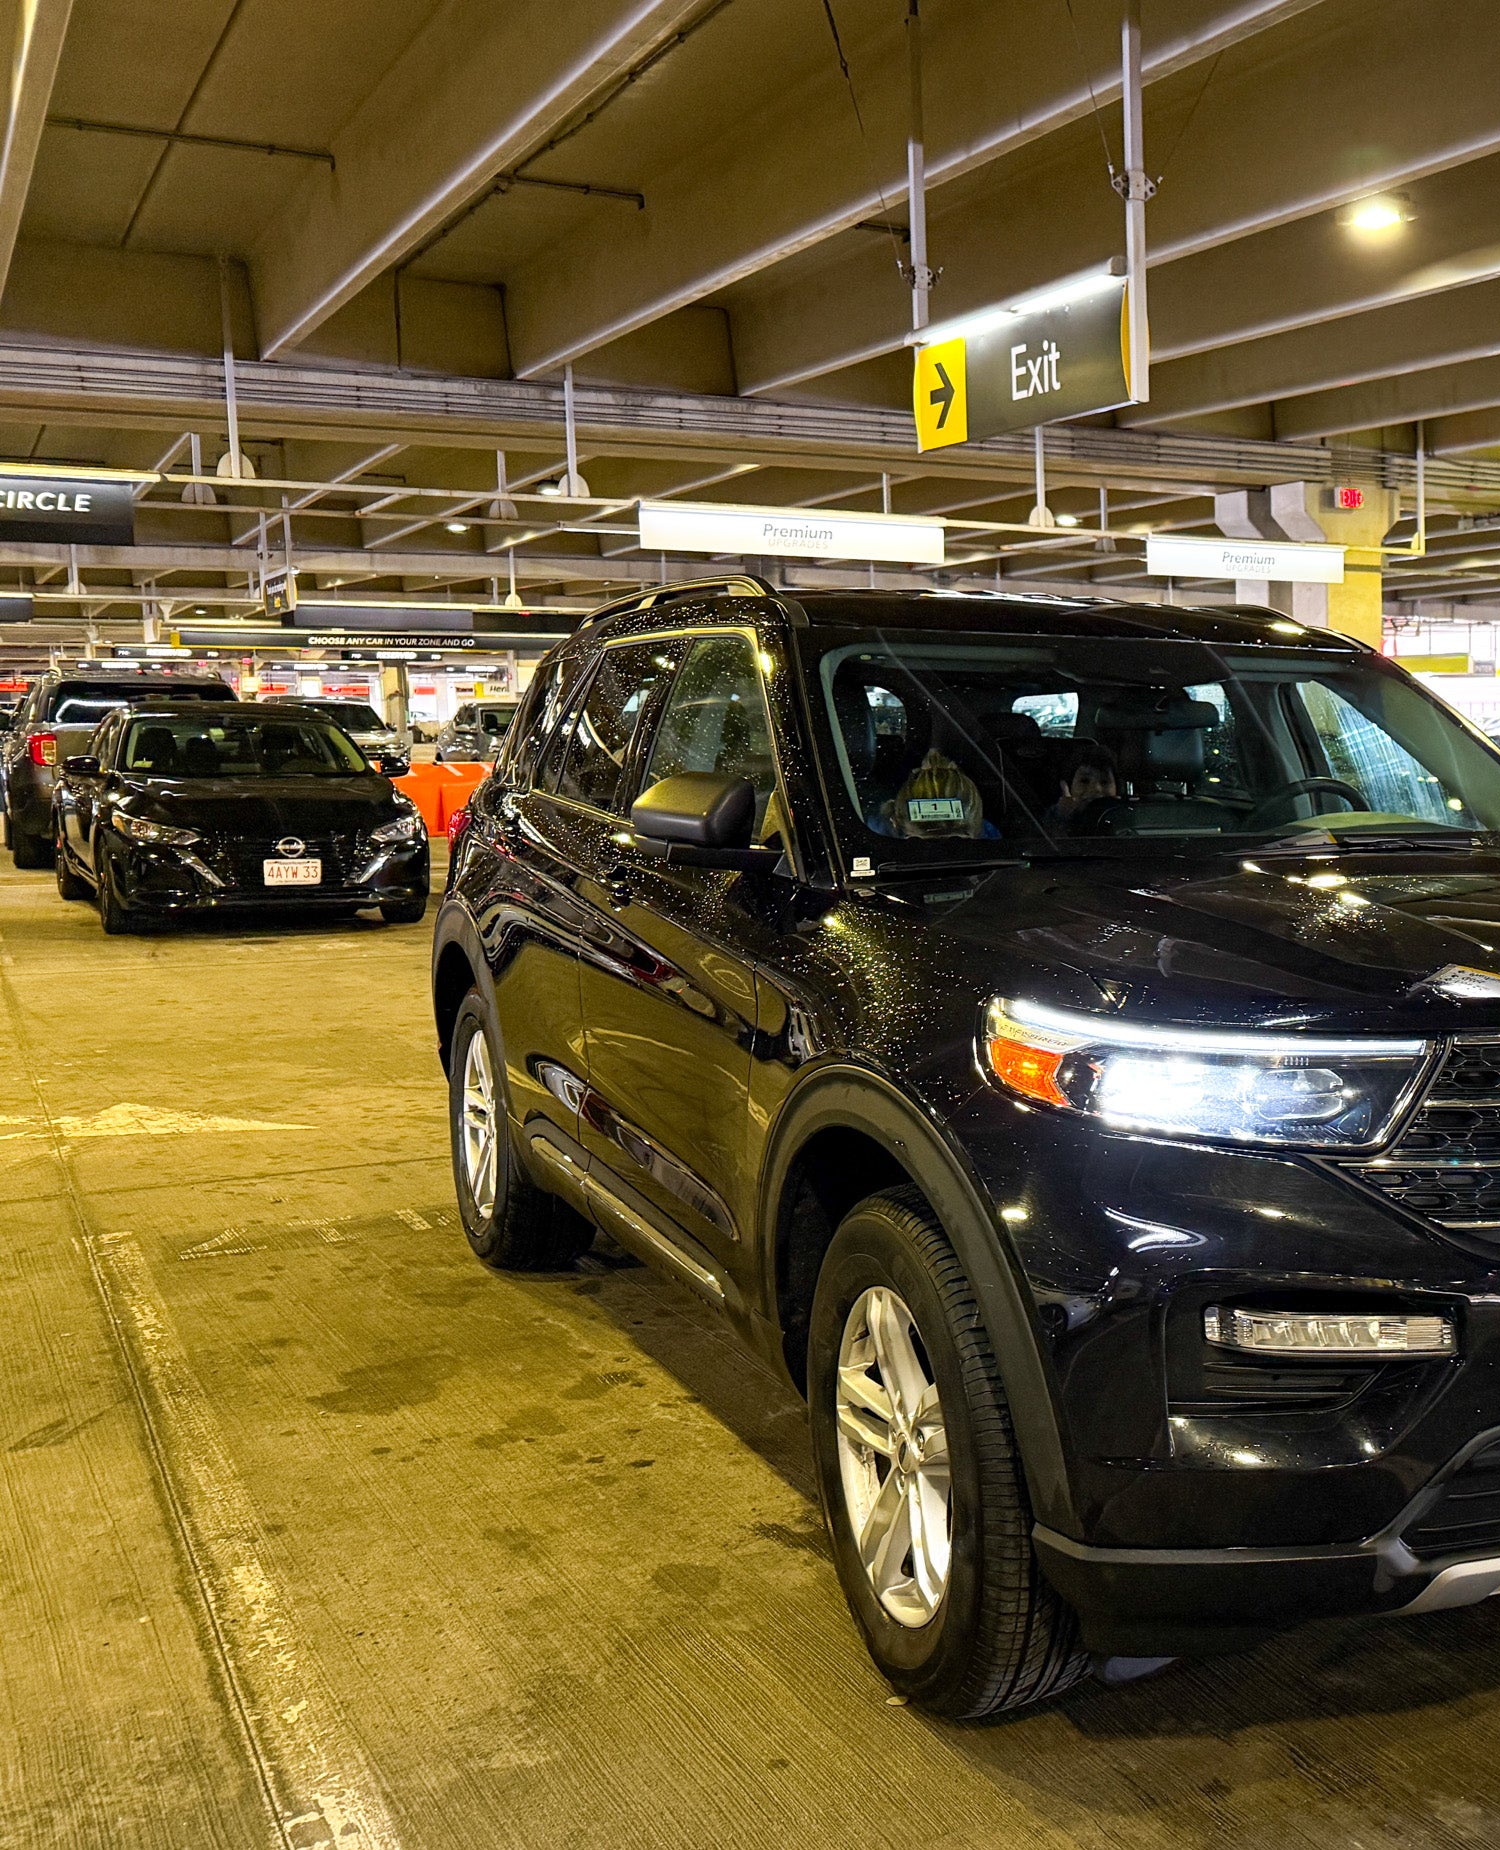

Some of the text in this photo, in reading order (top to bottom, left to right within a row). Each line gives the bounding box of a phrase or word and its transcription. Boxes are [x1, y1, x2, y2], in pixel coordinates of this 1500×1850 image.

[1010, 339, 1061, 401] Exit
[0, 490, 92, 512] IRCLE
[763, 523, 833, 540] Premium
[768, 539, 829, 550] UPGRADES
[1222, 551, 1275, 566] Premium
[308, 636, 345, 645] CHOOSE
[346, 637, 365, 645] ANY
[366, 637, 383, 645] CAR
[394, 638, 418, 646] YOUR
[418, 638, 440, 646] ZONE
[442, 638, 460, 646] AND
[461, 638, 475, 647] GO
[268, 866, 318, 879] 4AYW 33
